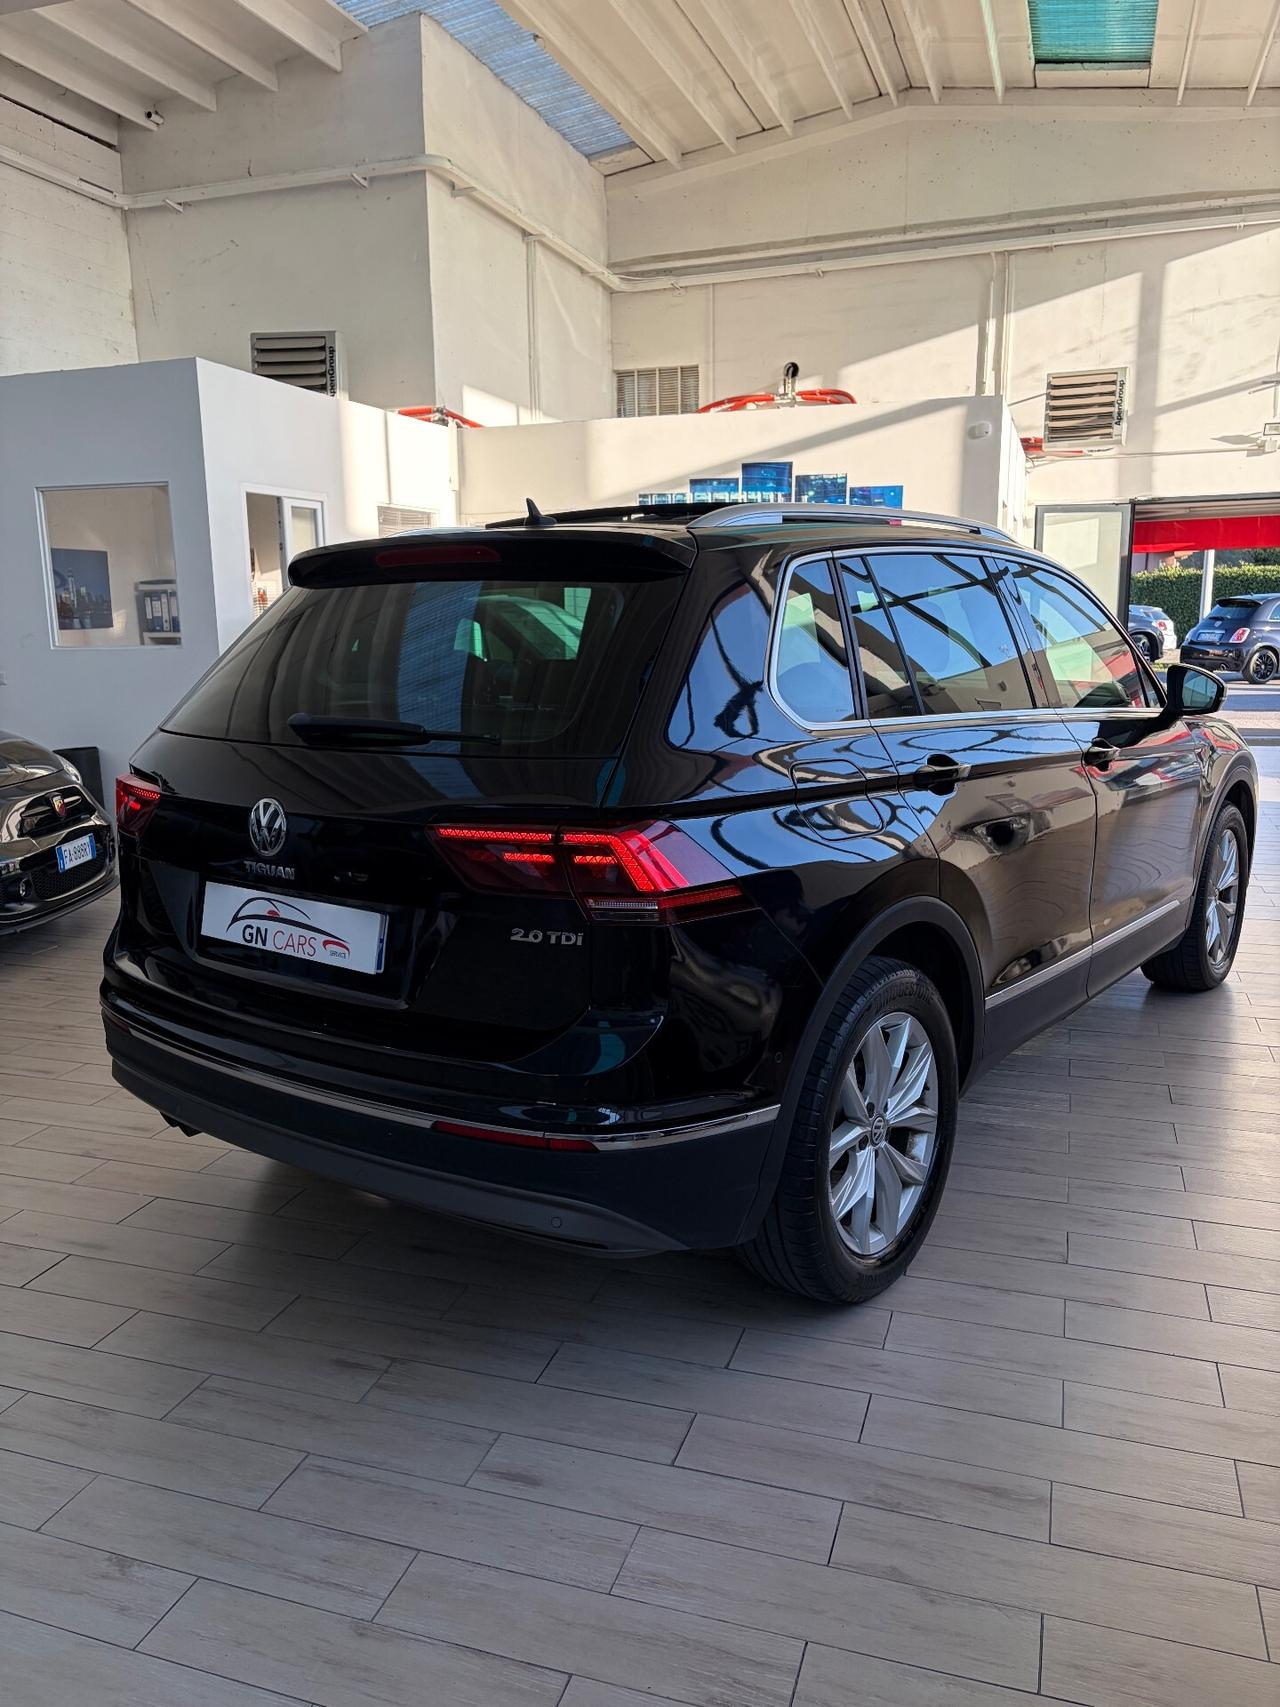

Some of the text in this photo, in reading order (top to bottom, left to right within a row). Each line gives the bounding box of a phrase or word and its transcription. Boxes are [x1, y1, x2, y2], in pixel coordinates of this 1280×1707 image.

[328, 345, 336, 397] penGroup
[1114, 379, 1126, 426] ApenGroup
[243, 860, 296, 880] TIGUAN
[242, 924, 317, 957] GN CARS
